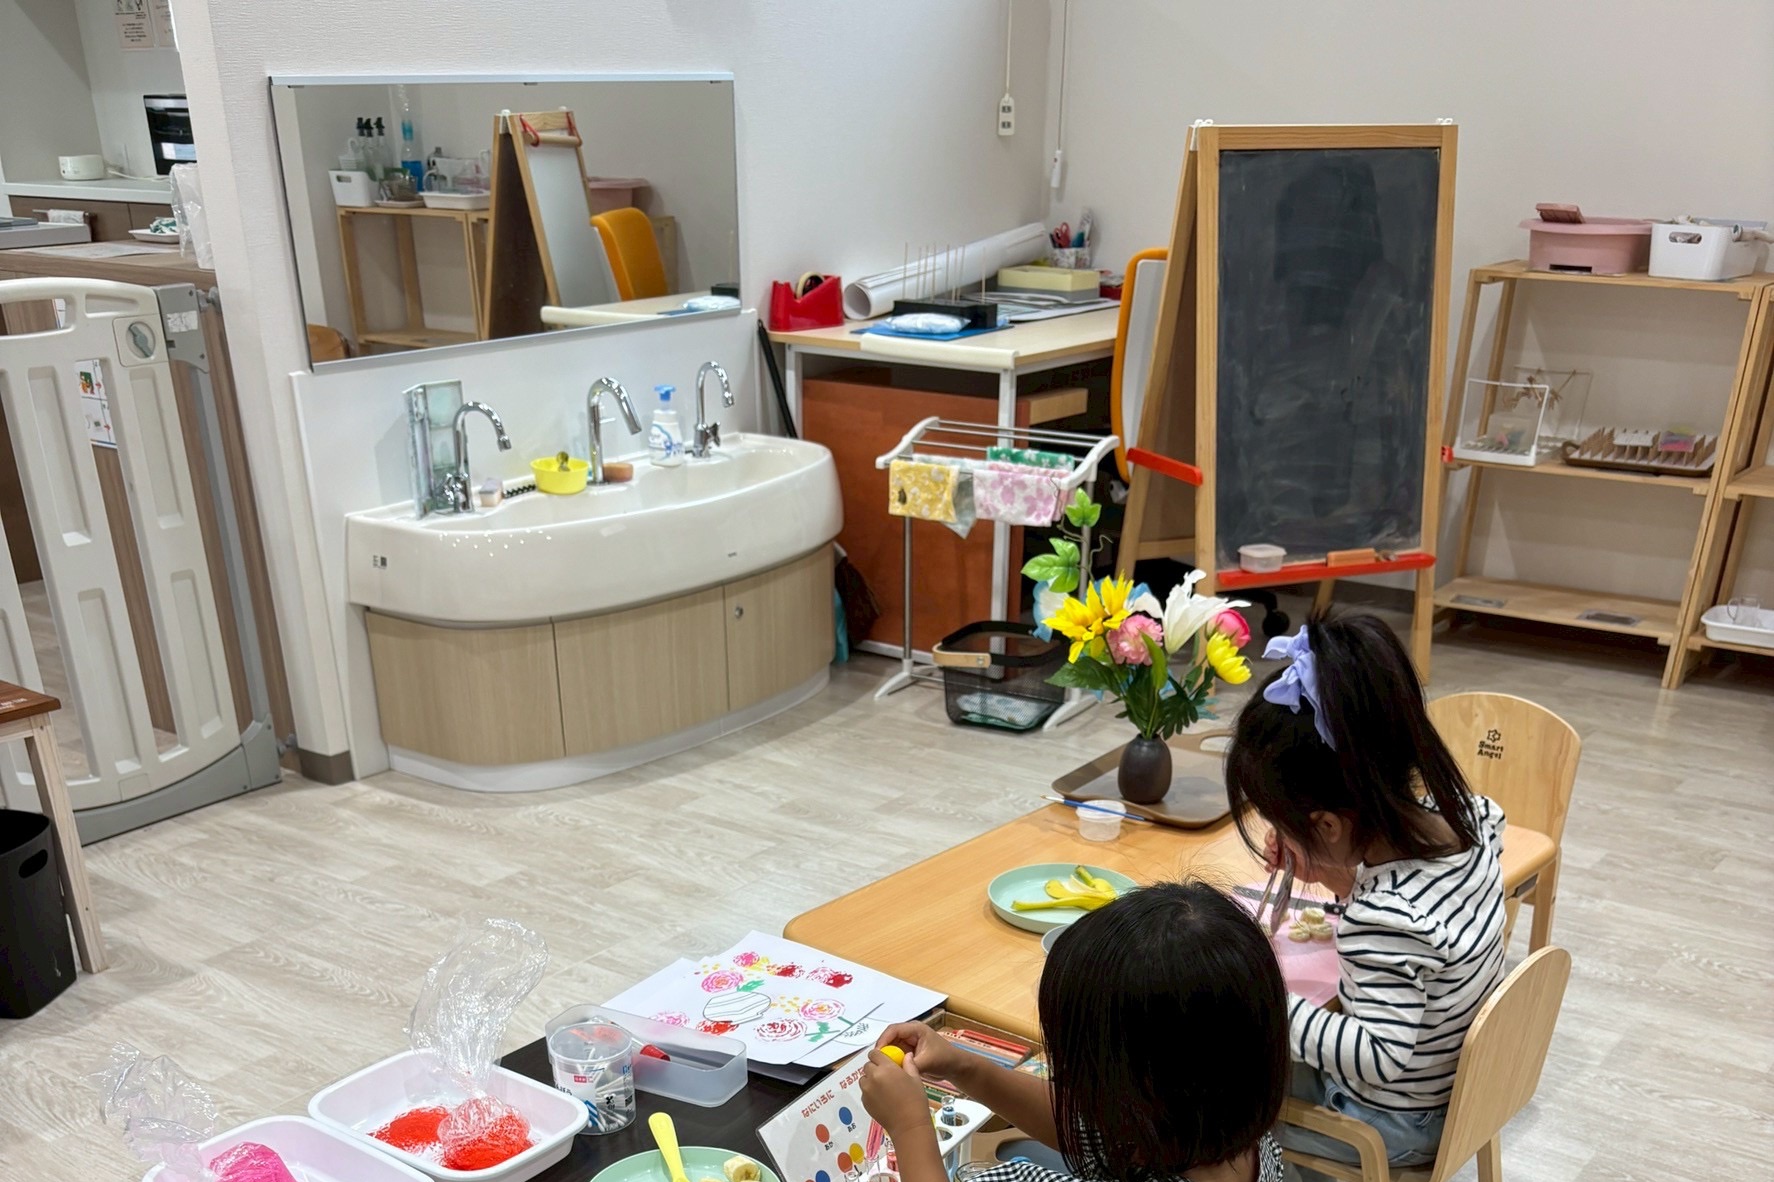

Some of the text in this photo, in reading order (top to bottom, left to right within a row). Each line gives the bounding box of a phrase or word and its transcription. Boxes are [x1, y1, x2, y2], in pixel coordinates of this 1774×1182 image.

[1479, 741, 1503, 752] Smart
[1477, 749, 1501, 759] Angel
[801, 1089, 835, 1118] なにいろに
